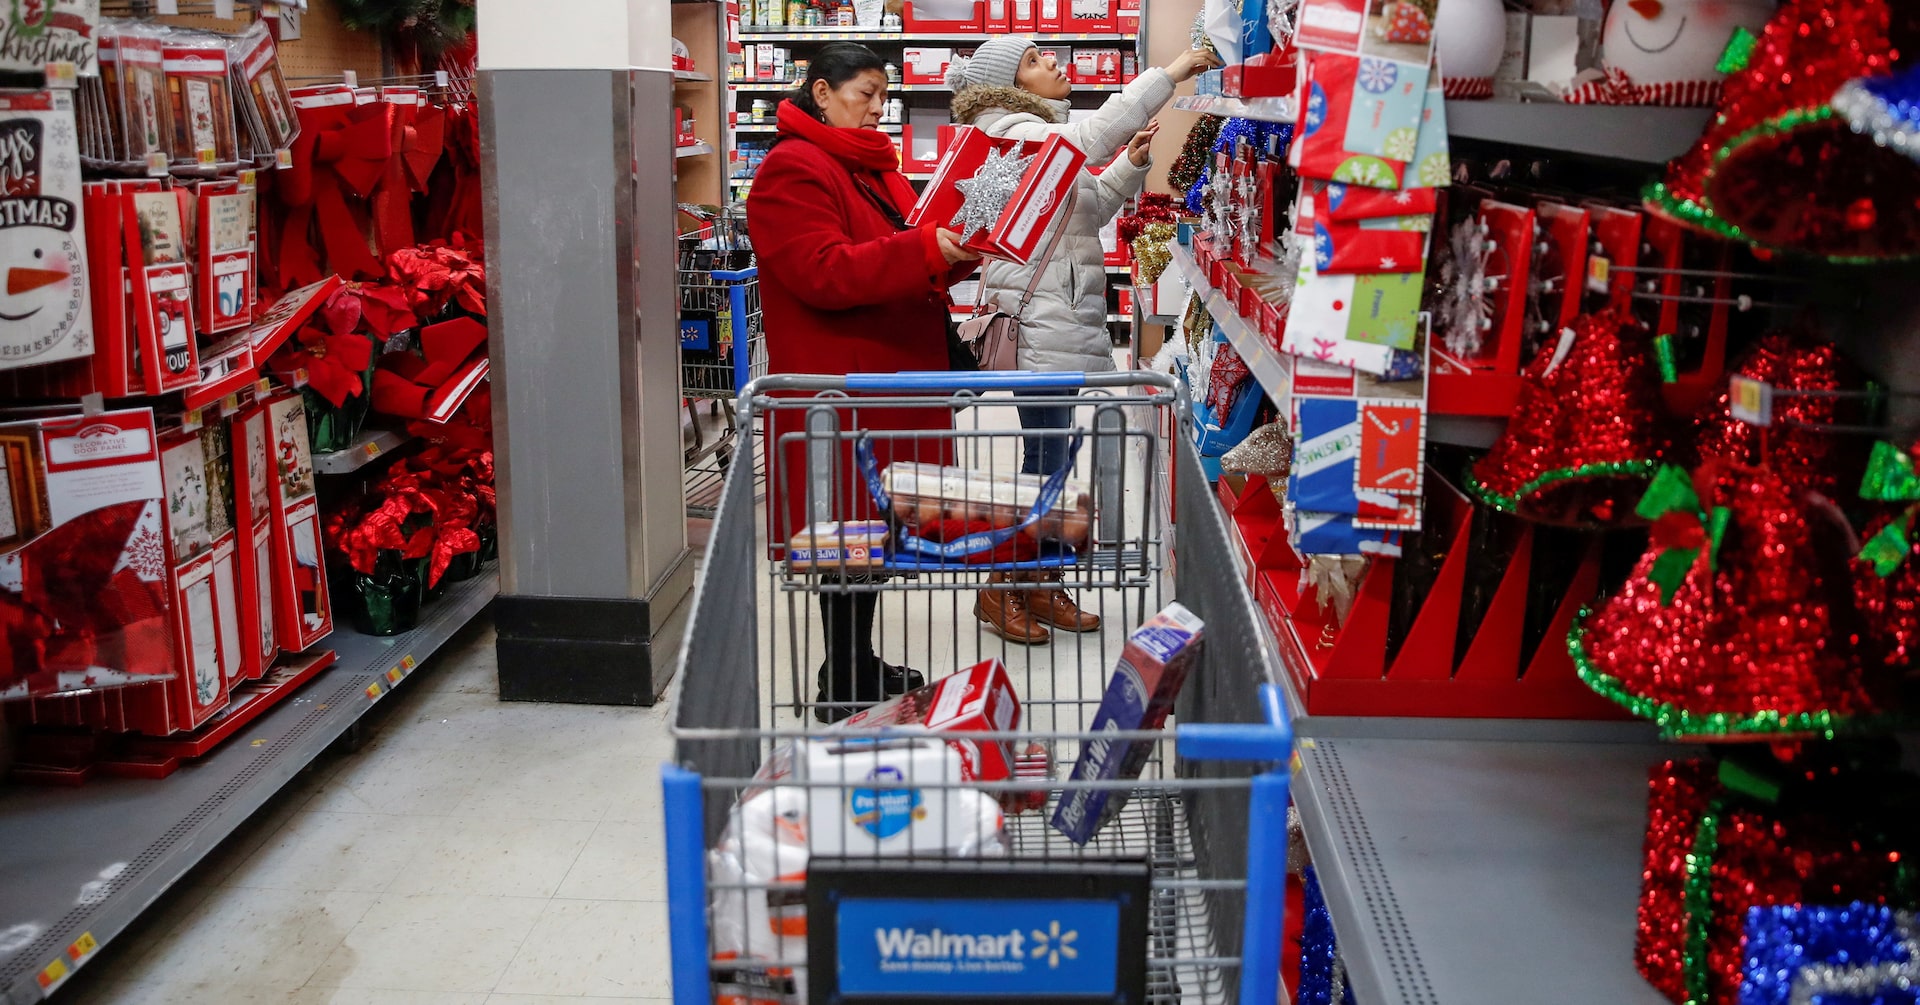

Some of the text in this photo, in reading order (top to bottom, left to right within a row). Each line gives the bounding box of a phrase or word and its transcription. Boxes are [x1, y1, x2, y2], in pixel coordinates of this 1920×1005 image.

[0, 23, 94, 70] hristmas
[62, 241, 71, 251] 25
[68, 252, 77, 261] 24
[72, 265, 80, 274] 23
[72, 277, 81, 287] 22
[73, 289, 80, 298] 21
[52, 329, 60, 338] 17
[73, 437, 126, 449] DECORATIVE
[74, 447, 98, 455] DOOR
[100, 443, 127, 452] PANEL
[798, 549, 840, 559] IMPEIAL
[1061, 757, 1100, 830] Reynlds
[1088, 718, 1119, 762] Wrp
[875, 928, 1025, 959] Walmart
